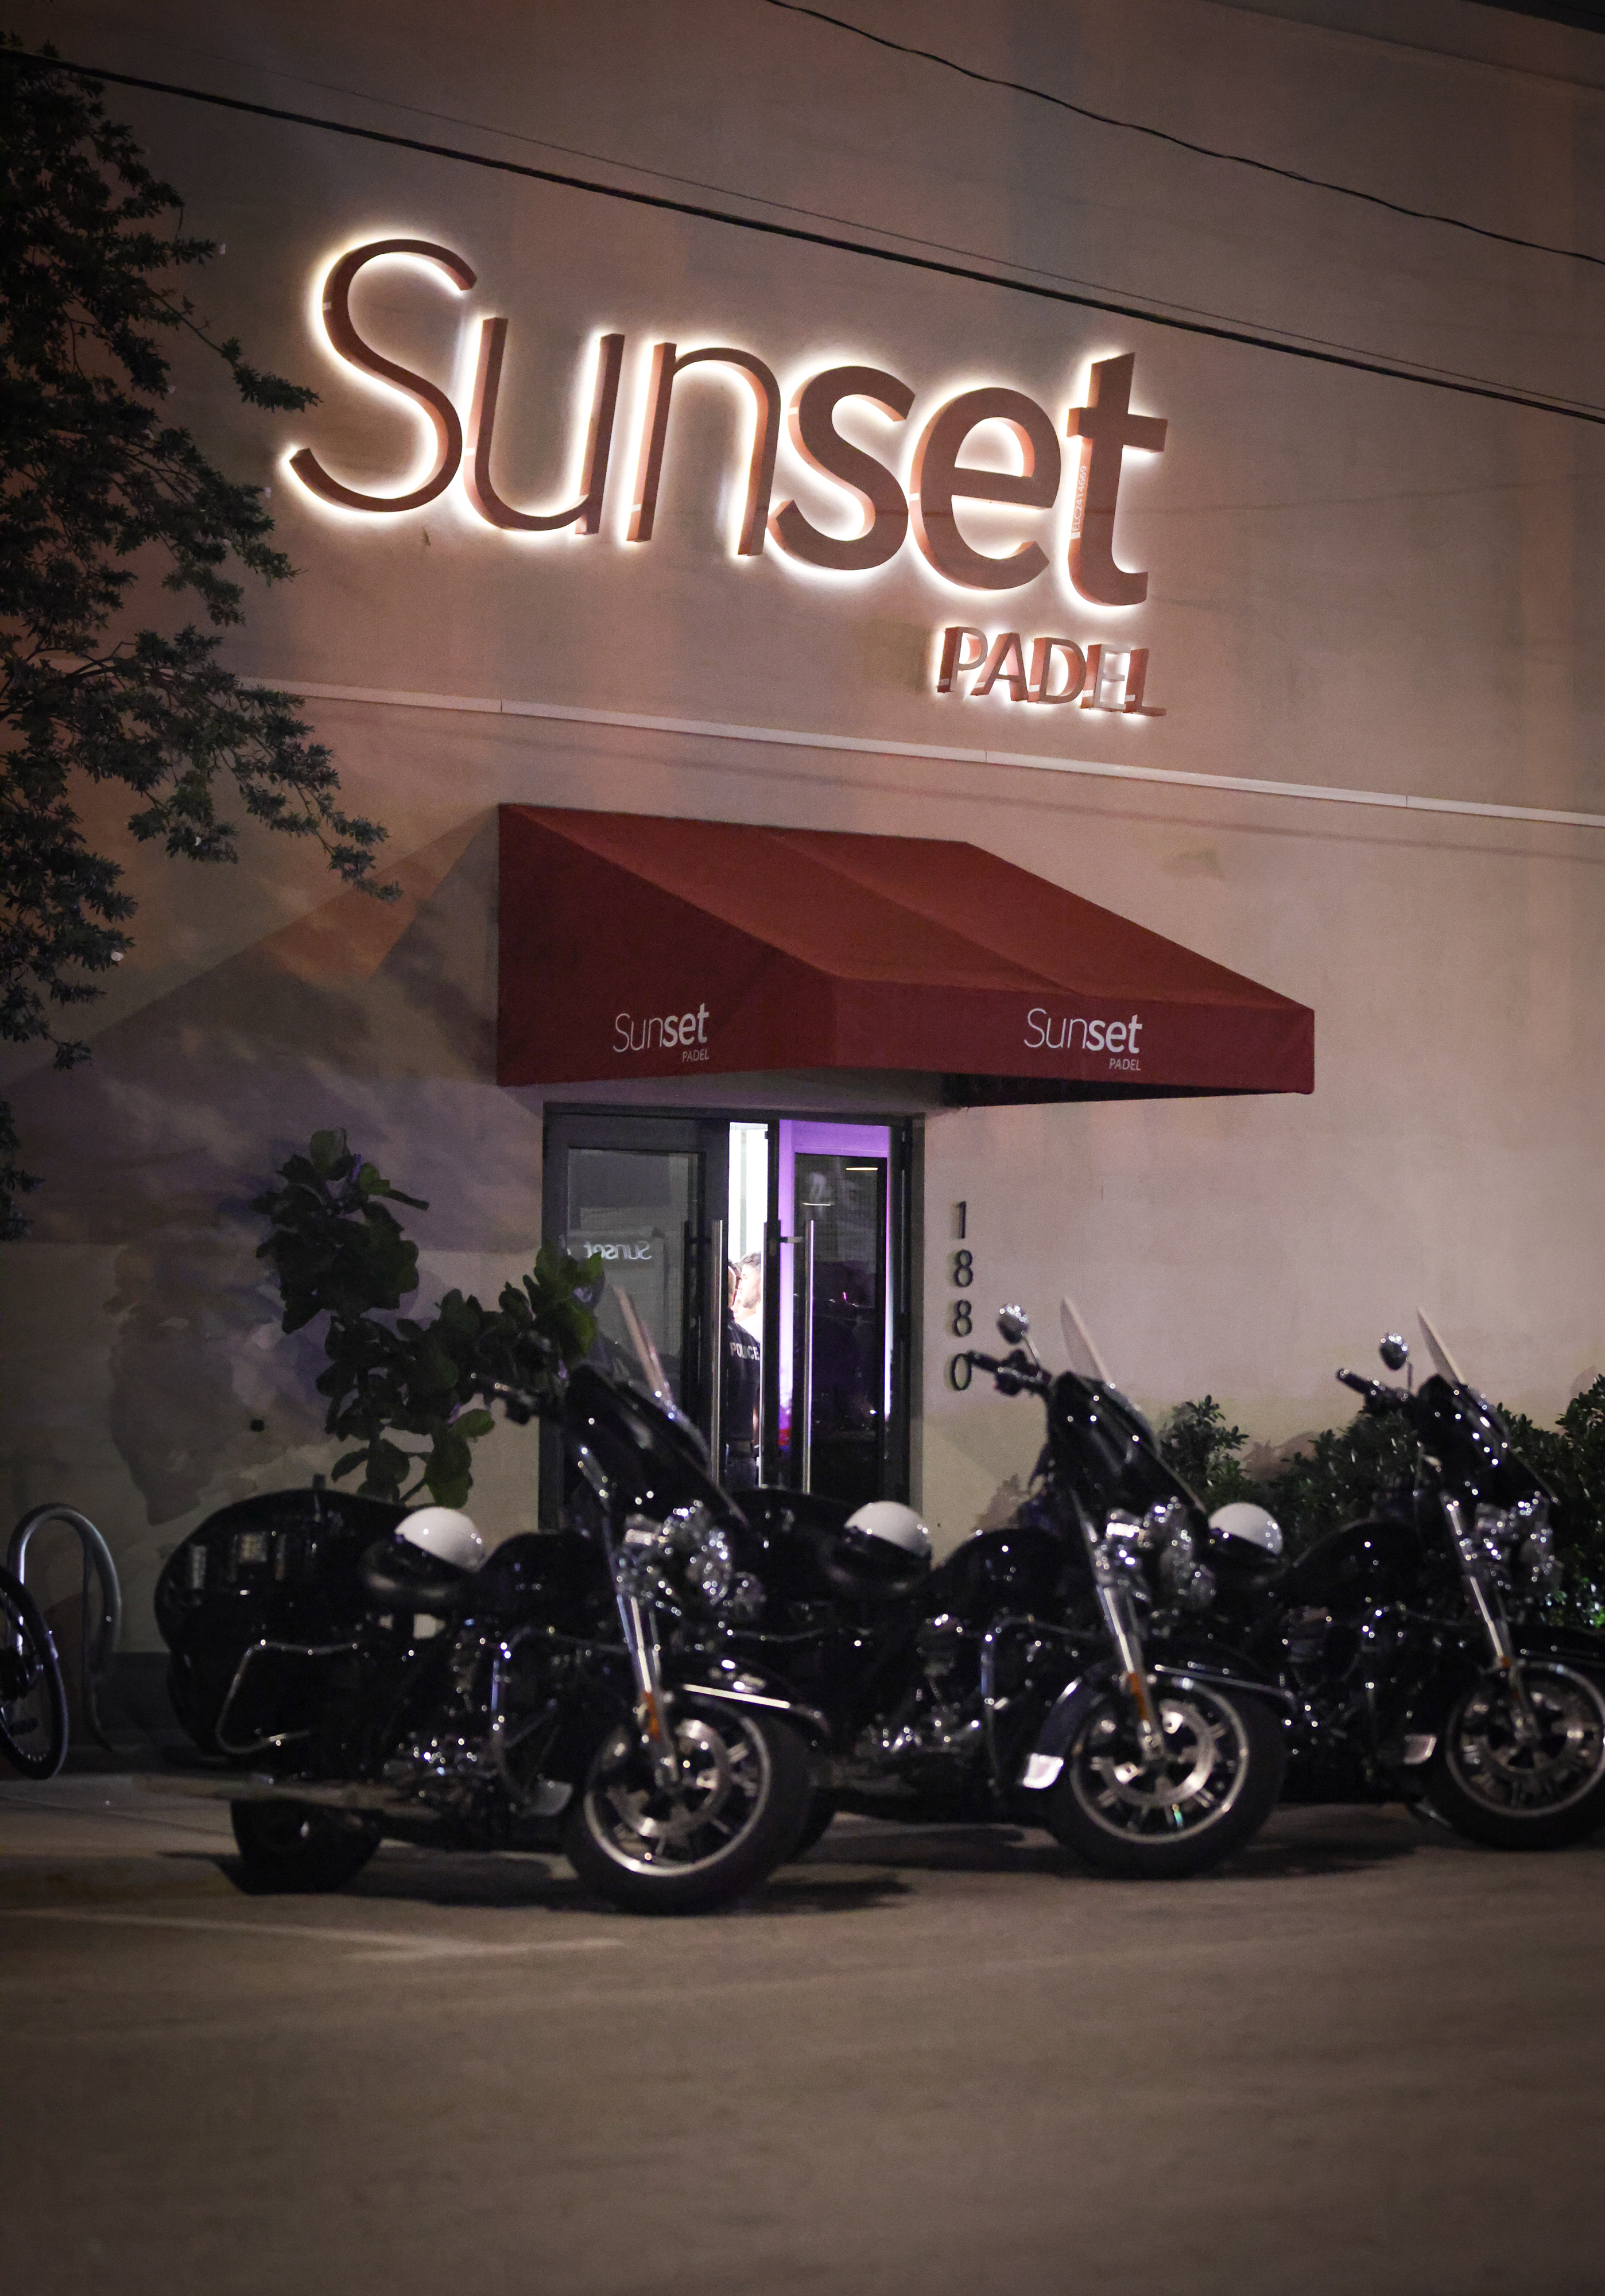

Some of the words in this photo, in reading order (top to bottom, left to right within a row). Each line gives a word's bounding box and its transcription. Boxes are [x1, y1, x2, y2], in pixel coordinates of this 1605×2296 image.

[290, 239, 1168, 606] Sunset
[1073, 466, 1087, 532] ELC2414669
[937, 626, 1167, 716] PADEL
[613, 1003, 710, 1053] Sunset
[1024, 1008, 1143, 1054] Sunset
[682, 1049, 710, 1062] PADEL
[1109, 1058, 1141, 1071] PADEL
[953, 1201, 974, 1391] 1880
[730, 1341, 760, 1361] POLICE
